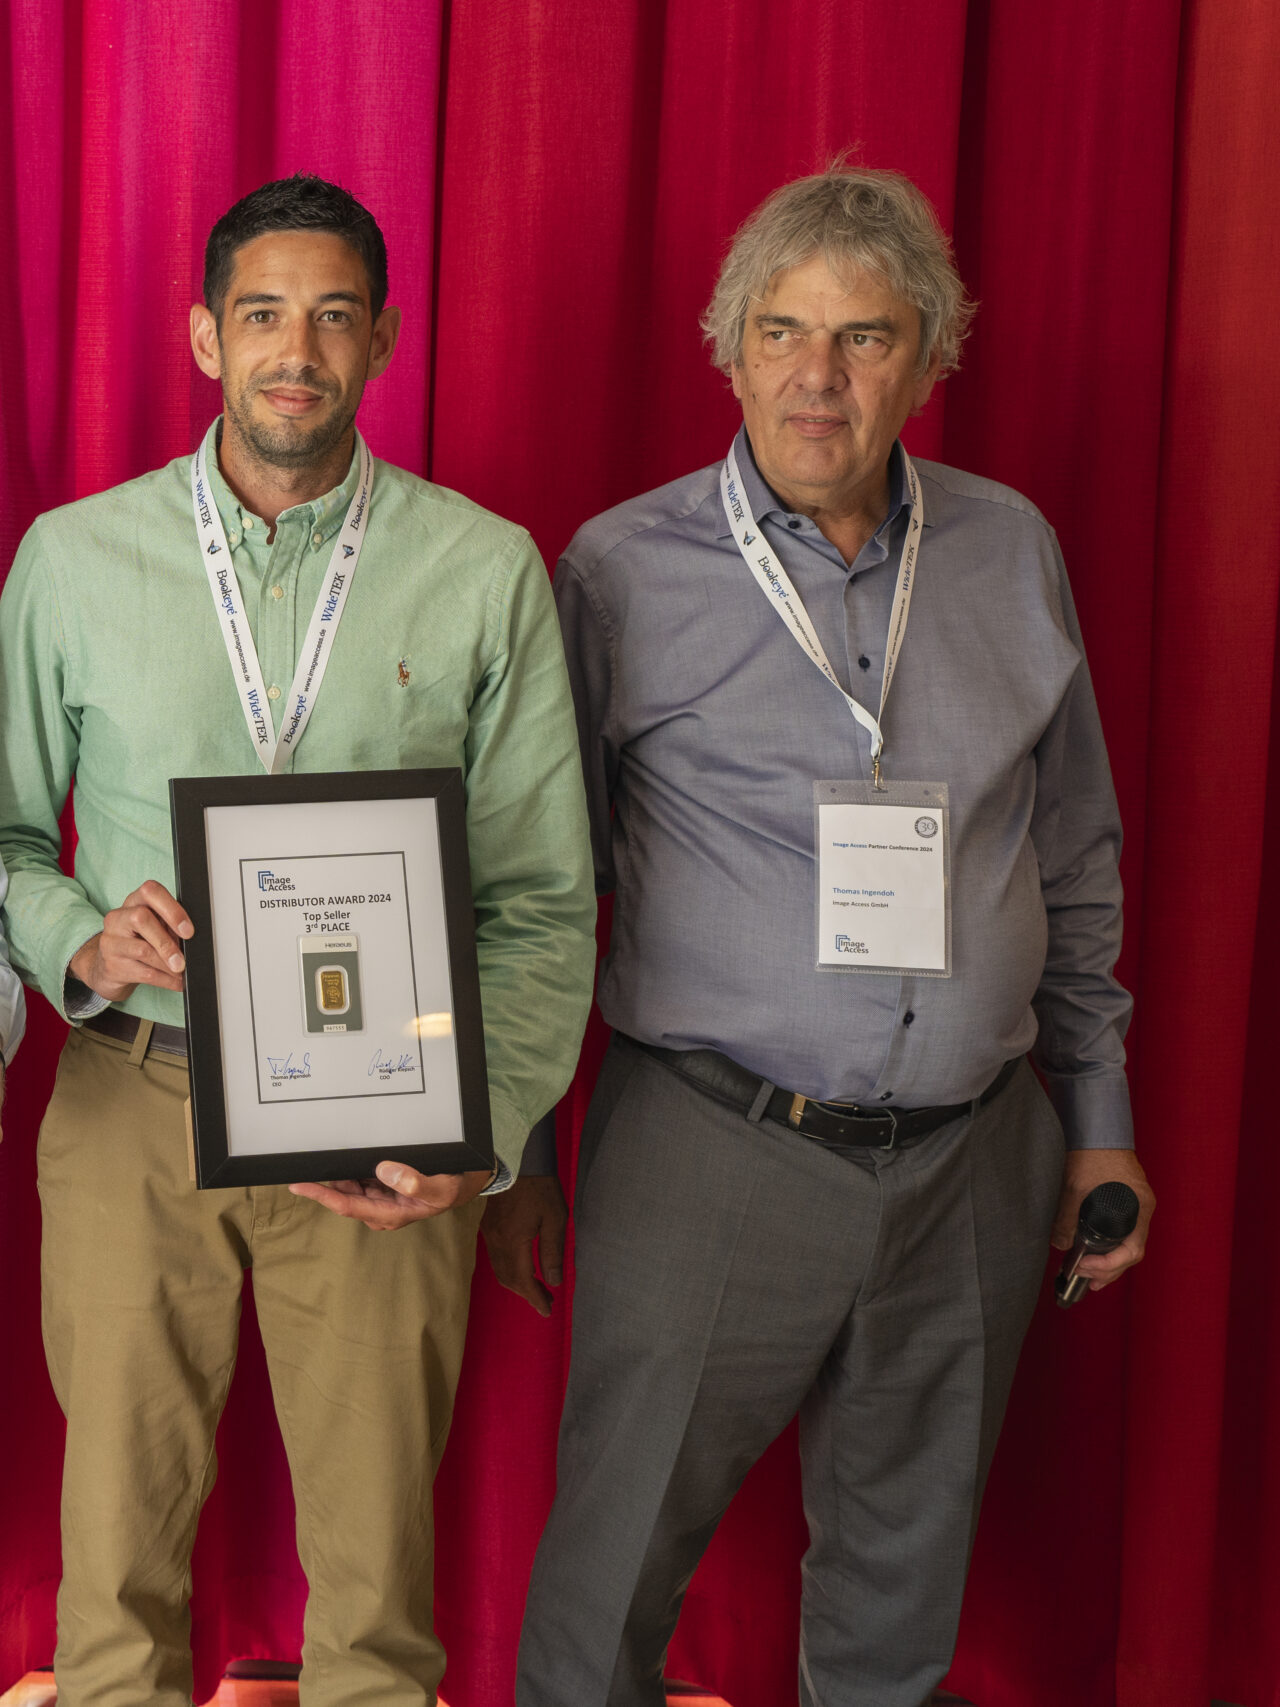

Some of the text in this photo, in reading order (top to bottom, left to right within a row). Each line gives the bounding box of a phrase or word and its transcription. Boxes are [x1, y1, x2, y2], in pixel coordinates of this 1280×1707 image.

[726, 480, 745, 522] WideTEK
[758, 556, 789, 599] Bookeye
[195, 479, 269, 745] WideTEK Bookeye www.imageaccess.de WideTEK
[283, 694, 307, 744] Bookeye
[304, 629, 326, 692] www.imageaccess.de
[321, 571, 346, 622] WideTEK
[920, 822, 934, 832] 30
[264, 877, 291, 885] Image
[268, 884, 296, 892] Access
[832, 887, 895, 897] Thomas Ingendoh
[260, 893, 392, 909] DISTRIBUTOR AWARD 2024
[303, 910, 350, 922] Top Seller
[305, 922, 350, 933] 3rd PLACE
[840, 940, 865, 948] Image
